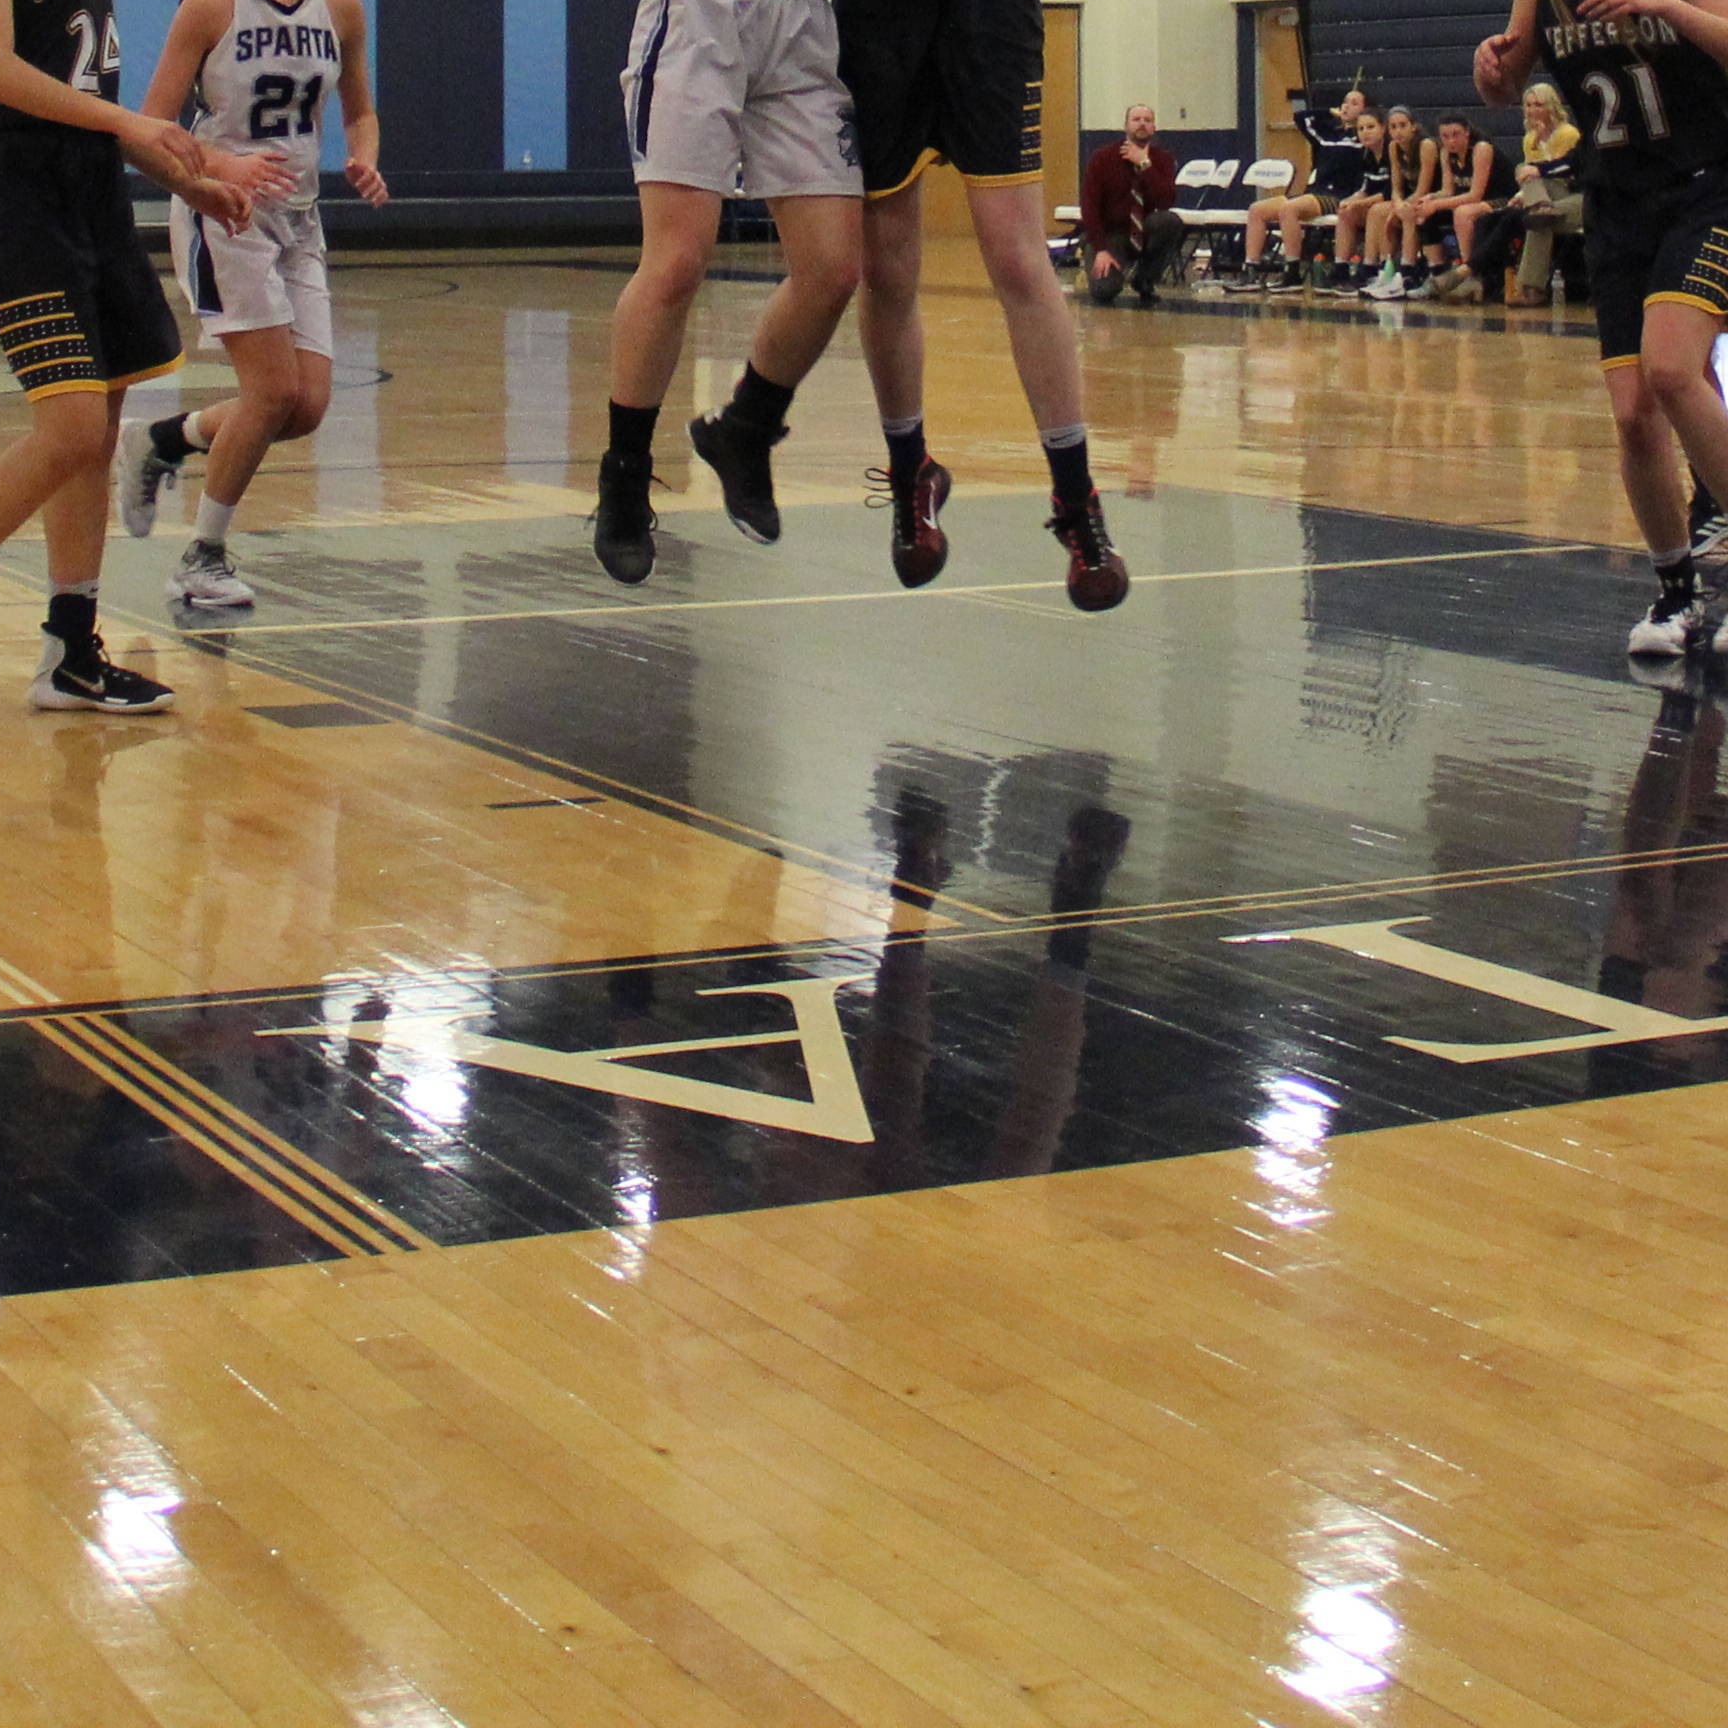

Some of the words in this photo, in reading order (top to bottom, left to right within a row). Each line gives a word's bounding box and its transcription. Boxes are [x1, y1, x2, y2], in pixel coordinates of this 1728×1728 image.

[65, 9, 120, 96] 24
[235, 25, 338, 63] SPARTA
[250, 73, 324, 140] 21
[1582, 62, 1671, 150] 21
